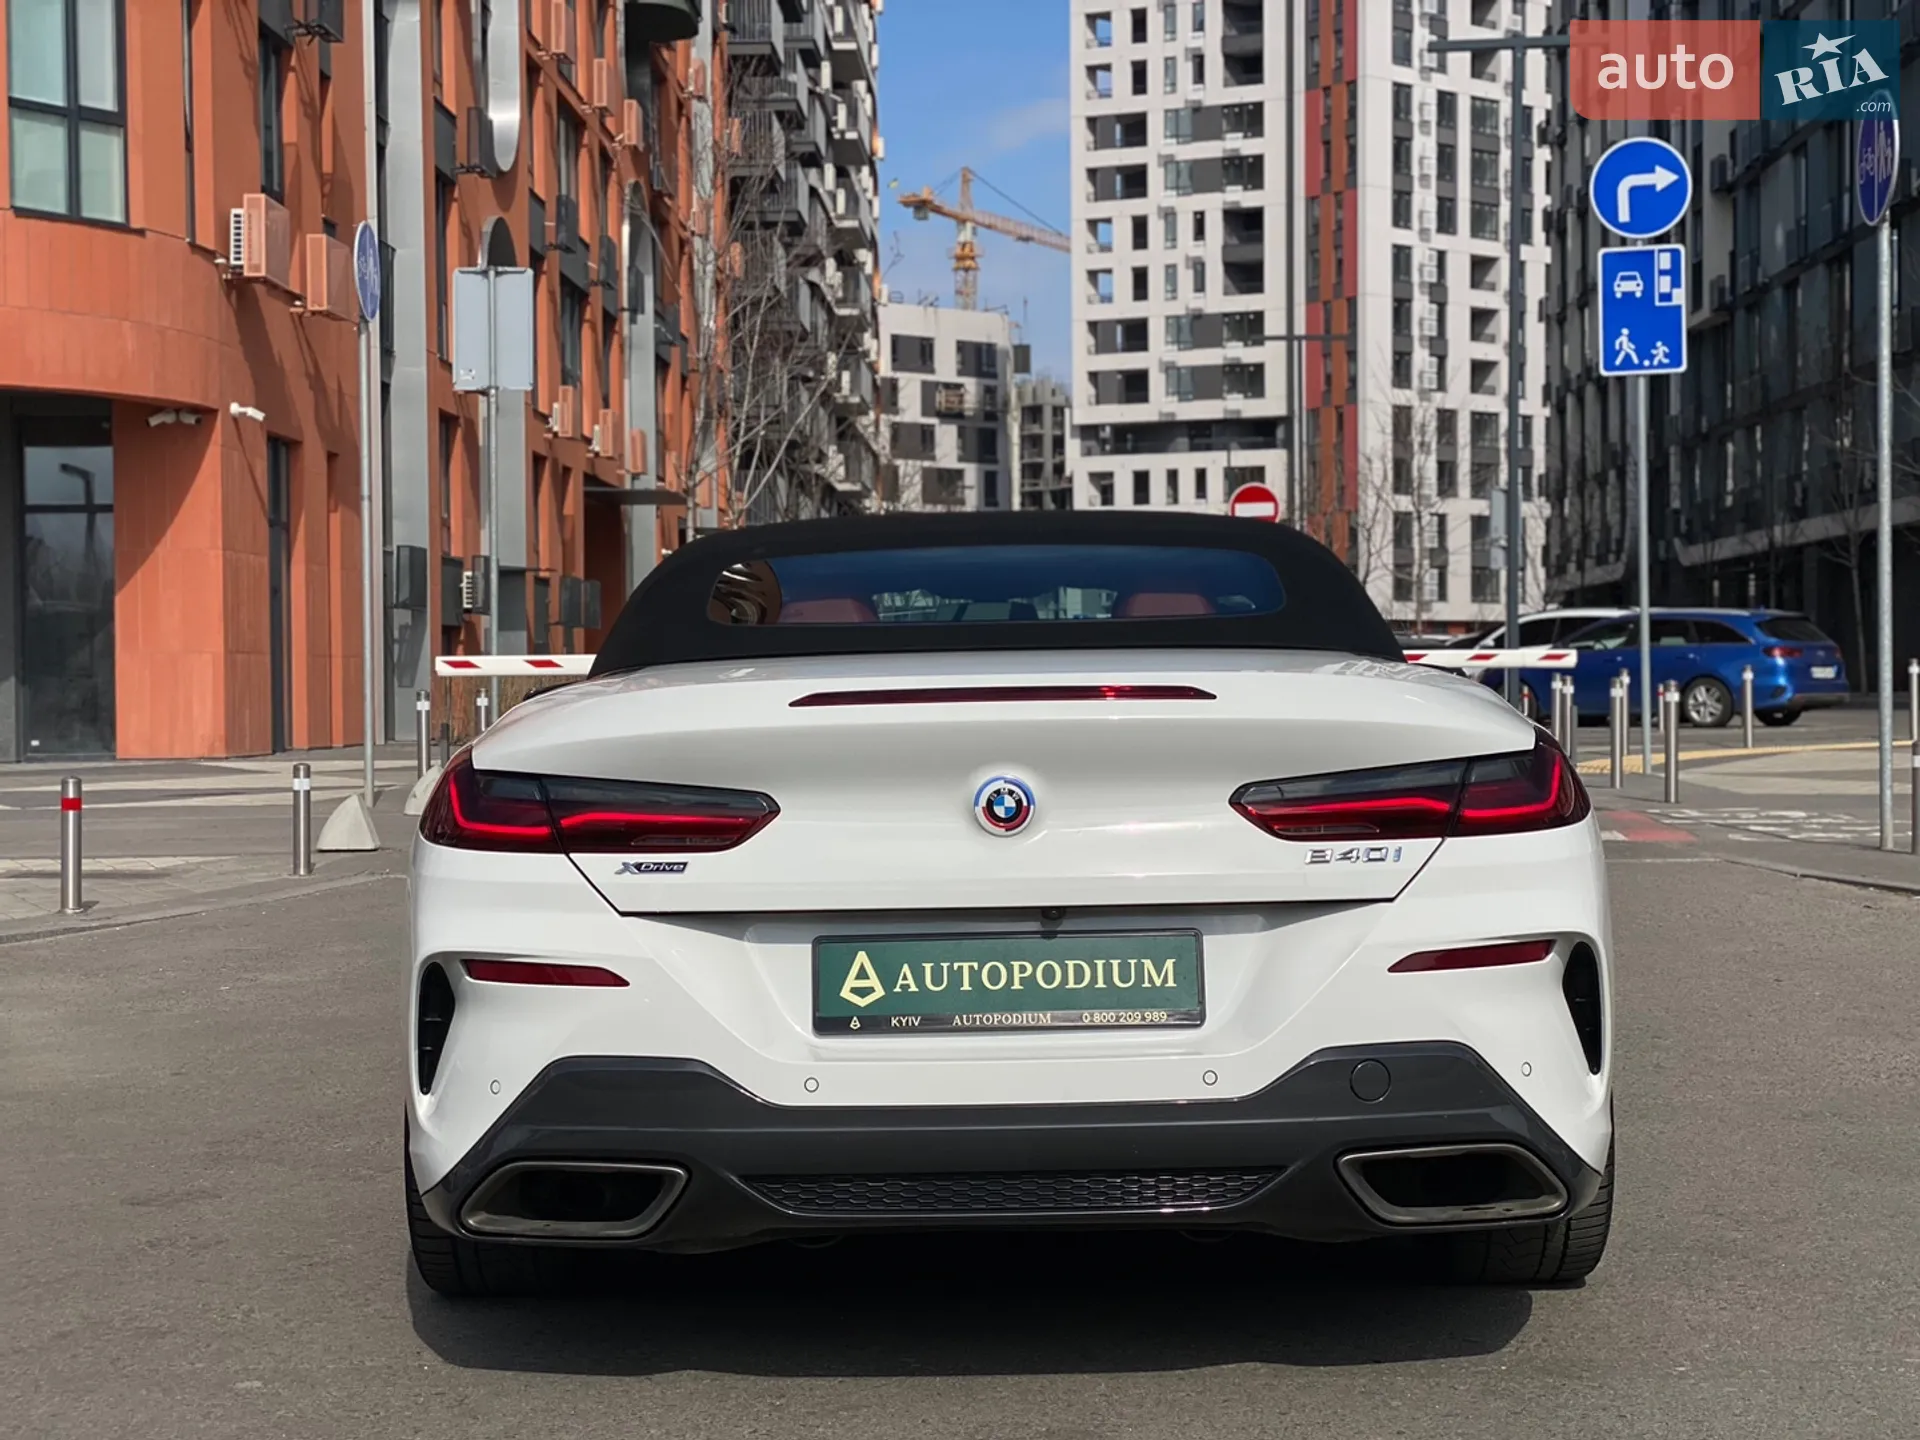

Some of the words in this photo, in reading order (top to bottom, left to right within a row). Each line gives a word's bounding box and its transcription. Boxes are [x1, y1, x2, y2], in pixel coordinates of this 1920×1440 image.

[893, 958, 1177, 992] AUTOPODIUM
[890, 1016, 921, 1028] KYIV
[952, 1012, 1051, 1027] AUTOPODIUM
[1082, 1012, 1090, 1023] 0
[1093, 1012, 1116, 1023] 800
[1119, 1011, 1142, 1023] 209
[1144, 1011, 1168, 1023] 989
